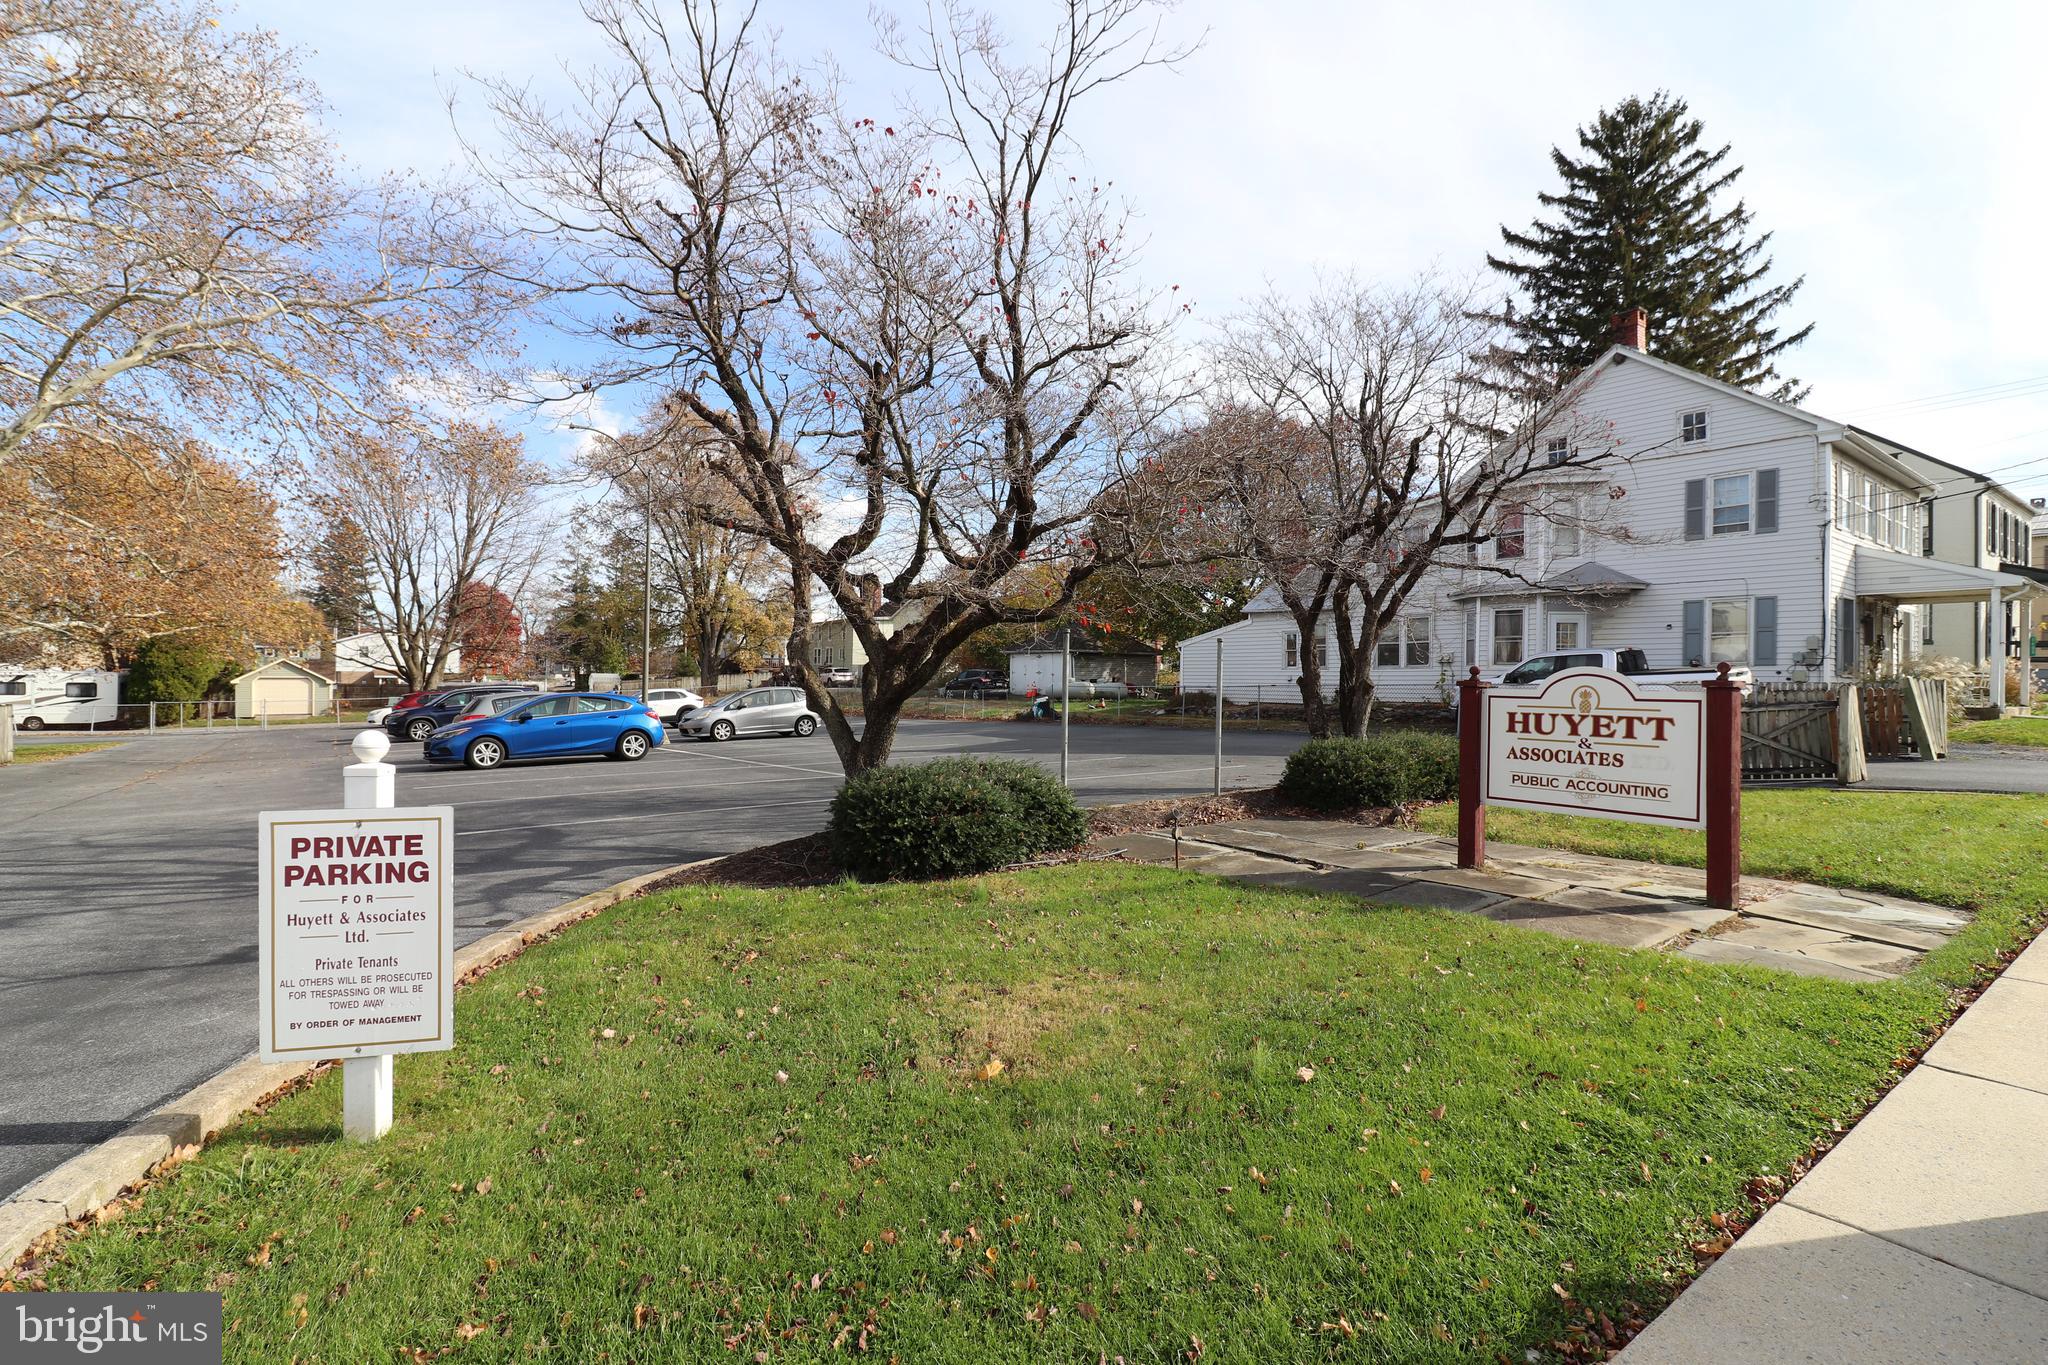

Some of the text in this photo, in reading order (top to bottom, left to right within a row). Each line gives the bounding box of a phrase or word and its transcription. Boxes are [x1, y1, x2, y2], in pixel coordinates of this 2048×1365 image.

[1506, 711, 1675, 741] HUYETT
[1578, 737, 1592, 749] &
[1507, 746, 1624, 768] ASSOCIATES
[1512, 774, 1669, 799] PUBLIC ACCOUNTING
[291, 834, 423, 859] PRIVATE
[284, 861, 429, 887] PARKING
[287, 909, 426, 929] Huyett & Associates
[345, 930, 369, 943] Ltd.
[315, 956, 398, 970] Private Tenants
[280, 980, 295, 988] ALL
[300, 978, 333, 986] OTHERS
[338, 976, 357, 984] WILL
[376, 972, 432, 982] PROSECUTED
[289, 992, 306, 1000] FOR
[311, 988, 369, 998] TRESPASSING
[374, 987, 385, 995] OR
[389, 986, 408, 994] WILL
[329, 1000, 384, 1009] TOWED AWAY
[306, 1020, 338, 1028] ORDER
[359, 1015, 422, 1025] MANAGEMENT
